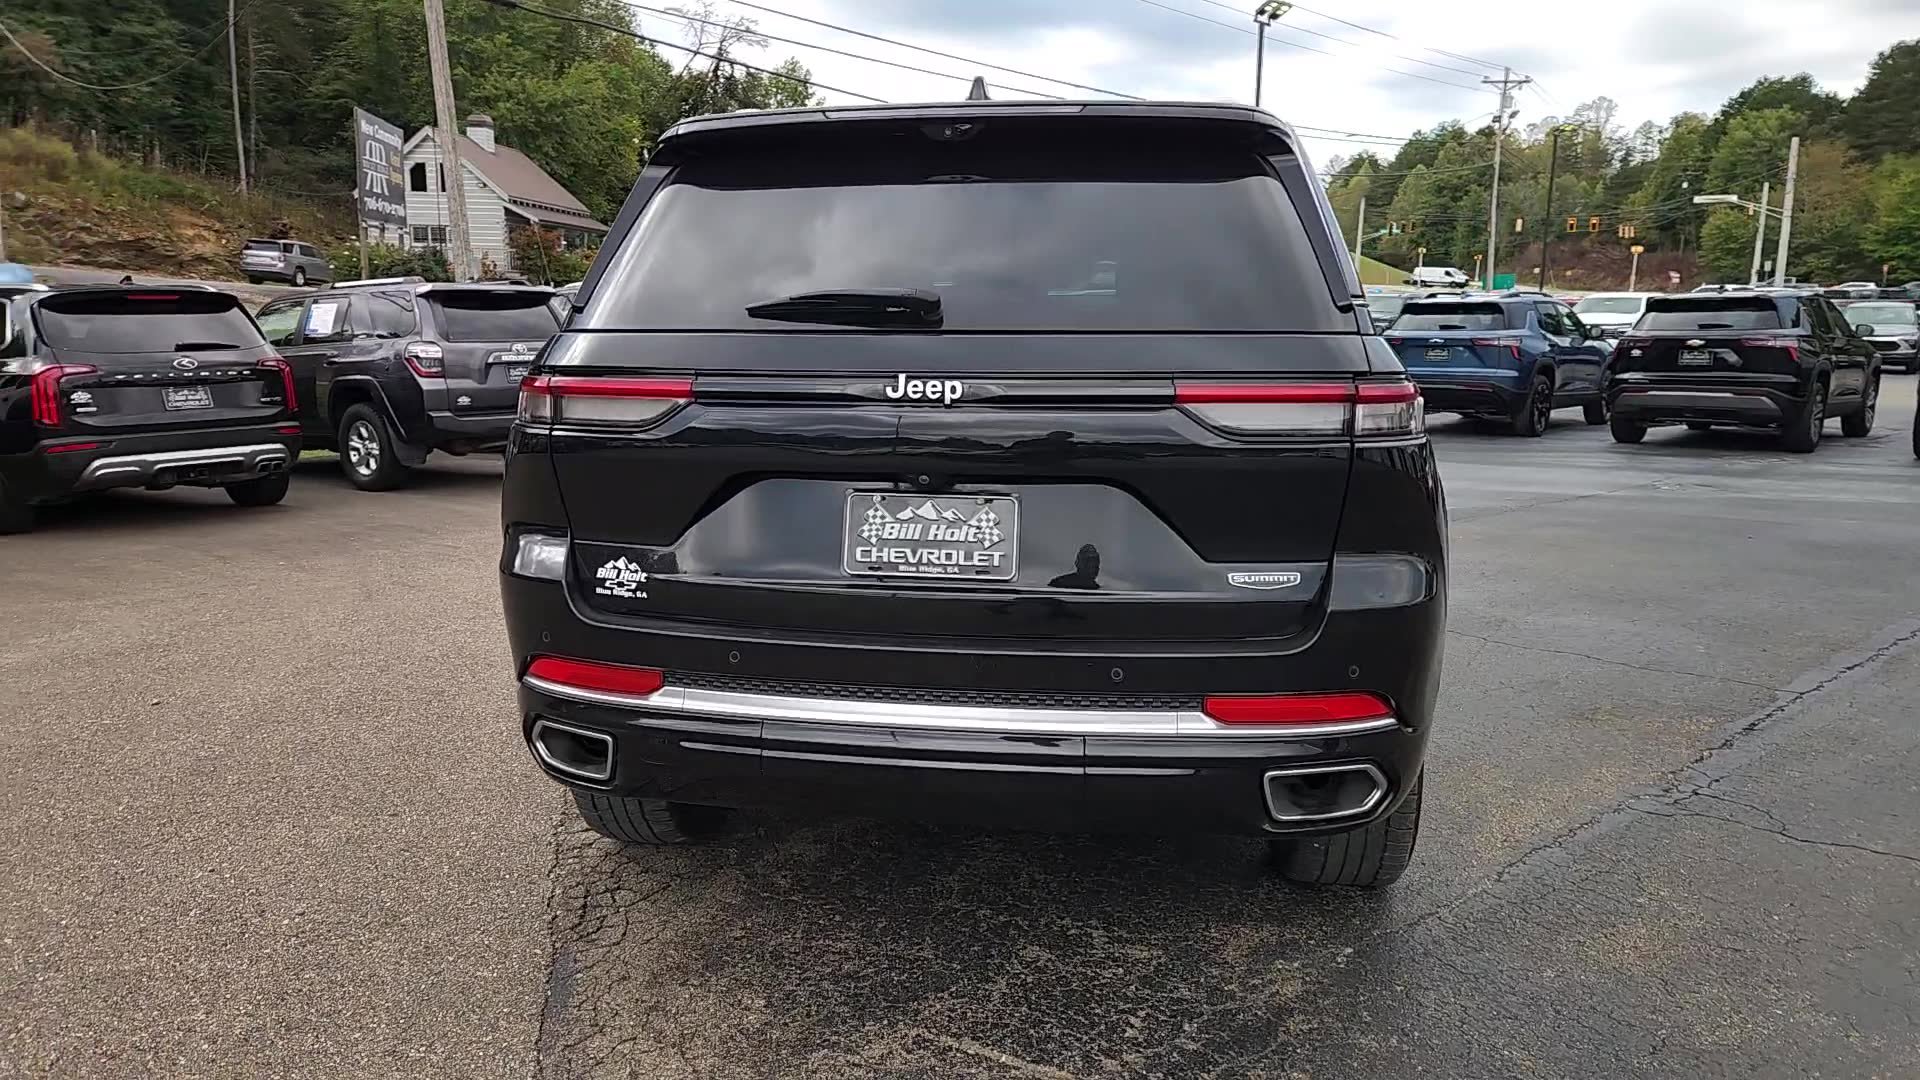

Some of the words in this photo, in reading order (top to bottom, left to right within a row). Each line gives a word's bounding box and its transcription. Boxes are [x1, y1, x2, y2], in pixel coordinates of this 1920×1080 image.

[885, 373, 962, 404] Jeep
[881, 523, 922, 540] Bill
[927, 524, 980, 543] Holt
[855, 546, 1006, 567] CHEVROLET
[596, 567, 619, 579] Bill
[619, 569, 648, 582] Holt
[1232, 575, 1297, 583] SUMMIT
[636, 590, 648, 598] GA
